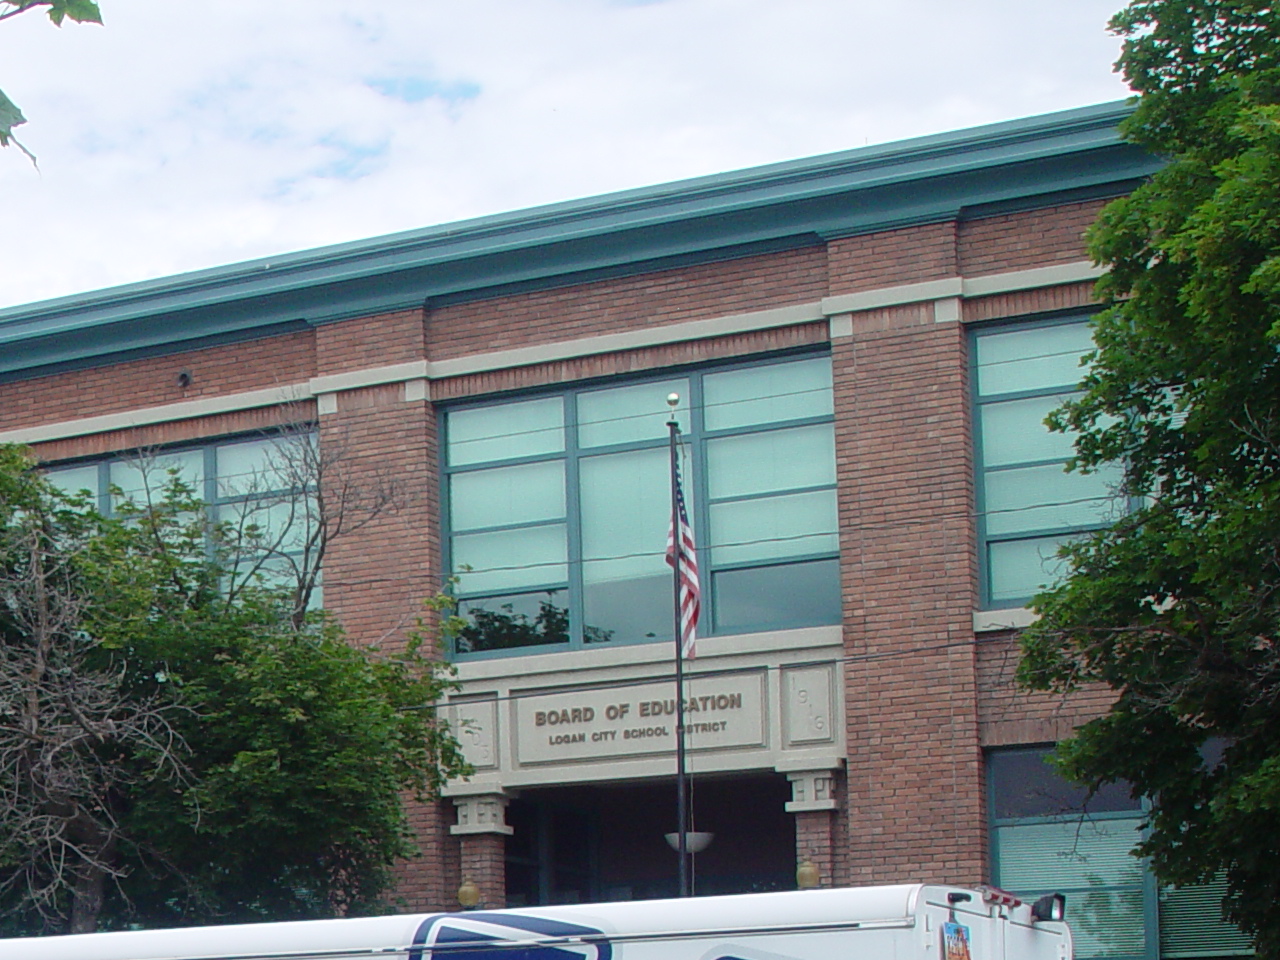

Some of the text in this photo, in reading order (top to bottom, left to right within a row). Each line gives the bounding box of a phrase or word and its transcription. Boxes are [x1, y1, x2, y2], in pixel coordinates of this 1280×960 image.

[535, 707, 595, 726] BOARD
[605, 703, 630, 720] OF
[549, 732, 585, 745] LOGAN
[591, 730, 617, 742] CITY
[623, 726, 669, 739] SCHOOL
